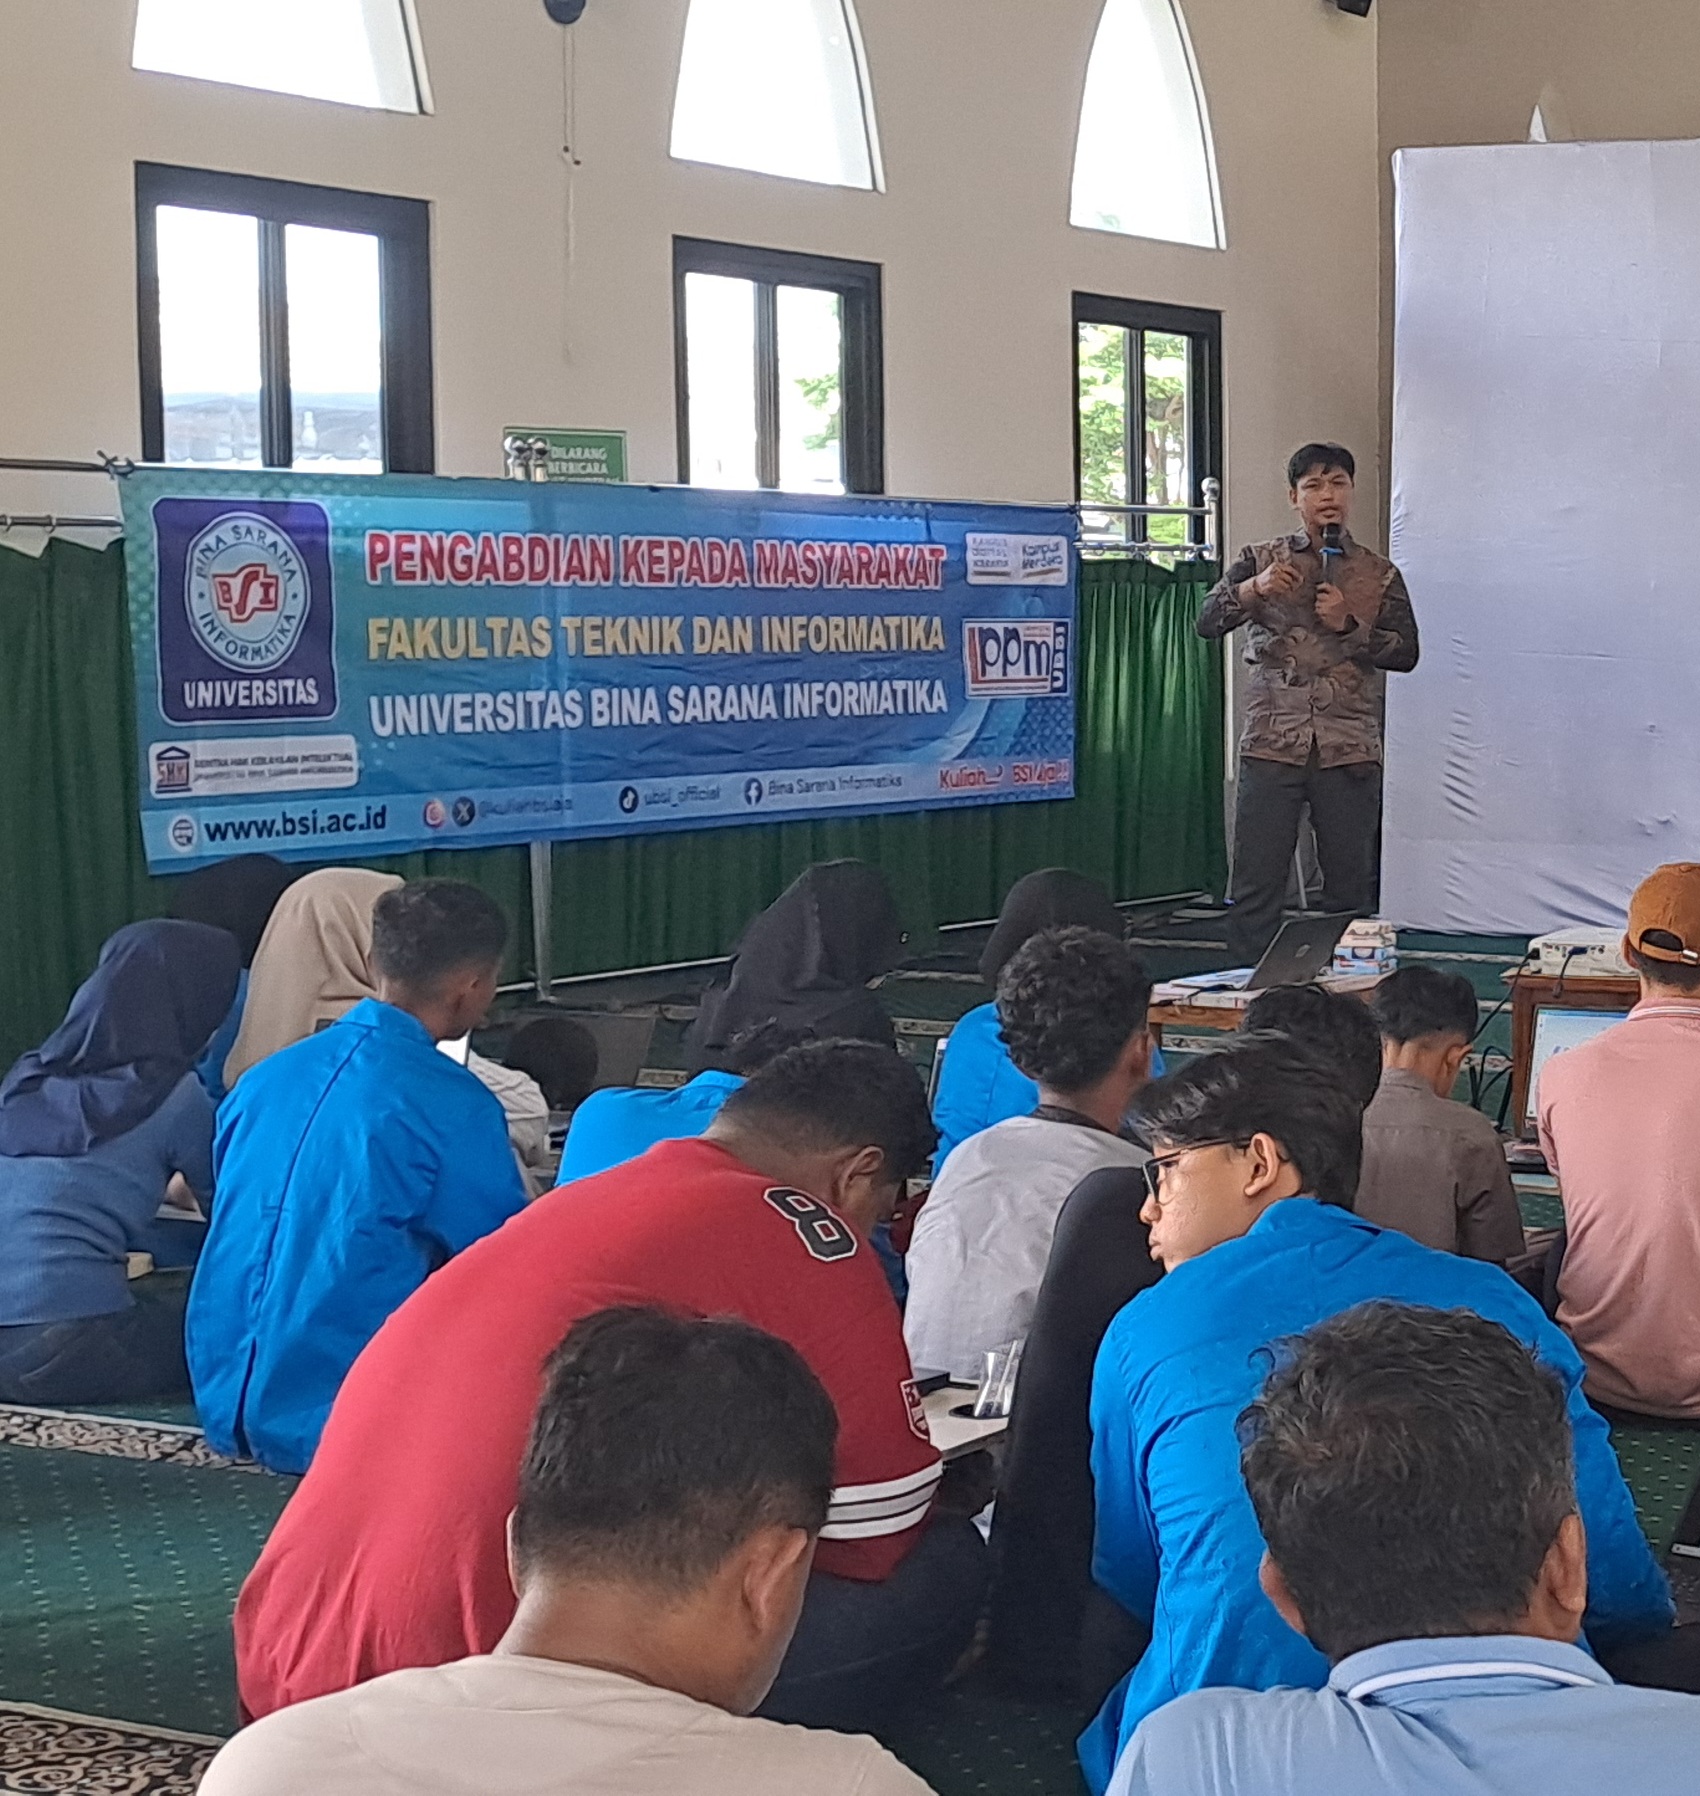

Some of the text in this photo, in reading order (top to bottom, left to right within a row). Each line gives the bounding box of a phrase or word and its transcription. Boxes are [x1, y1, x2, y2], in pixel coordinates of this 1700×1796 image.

[551, 447, 607, 460] DILARANG
[231, 524, 298, 583] SARANA
[366, 531, 946, 590] PENGABDIAN KEPADA MASYARAKAT
[199, 612, 297, 662] INFORMATIKA
[368, 615, 945, 660] FAKULTAS TEKNIK DAN INFORMATIKA
[183, 677, 319, 709] UNIVERSITAS
[369, 679, 948, 738] UNIVERSITAS BINA SARANA INFORMATIKA
[204, 804, 387, 842] www.bsi.ac.id
[763, 1185, 858, 1262] 8
